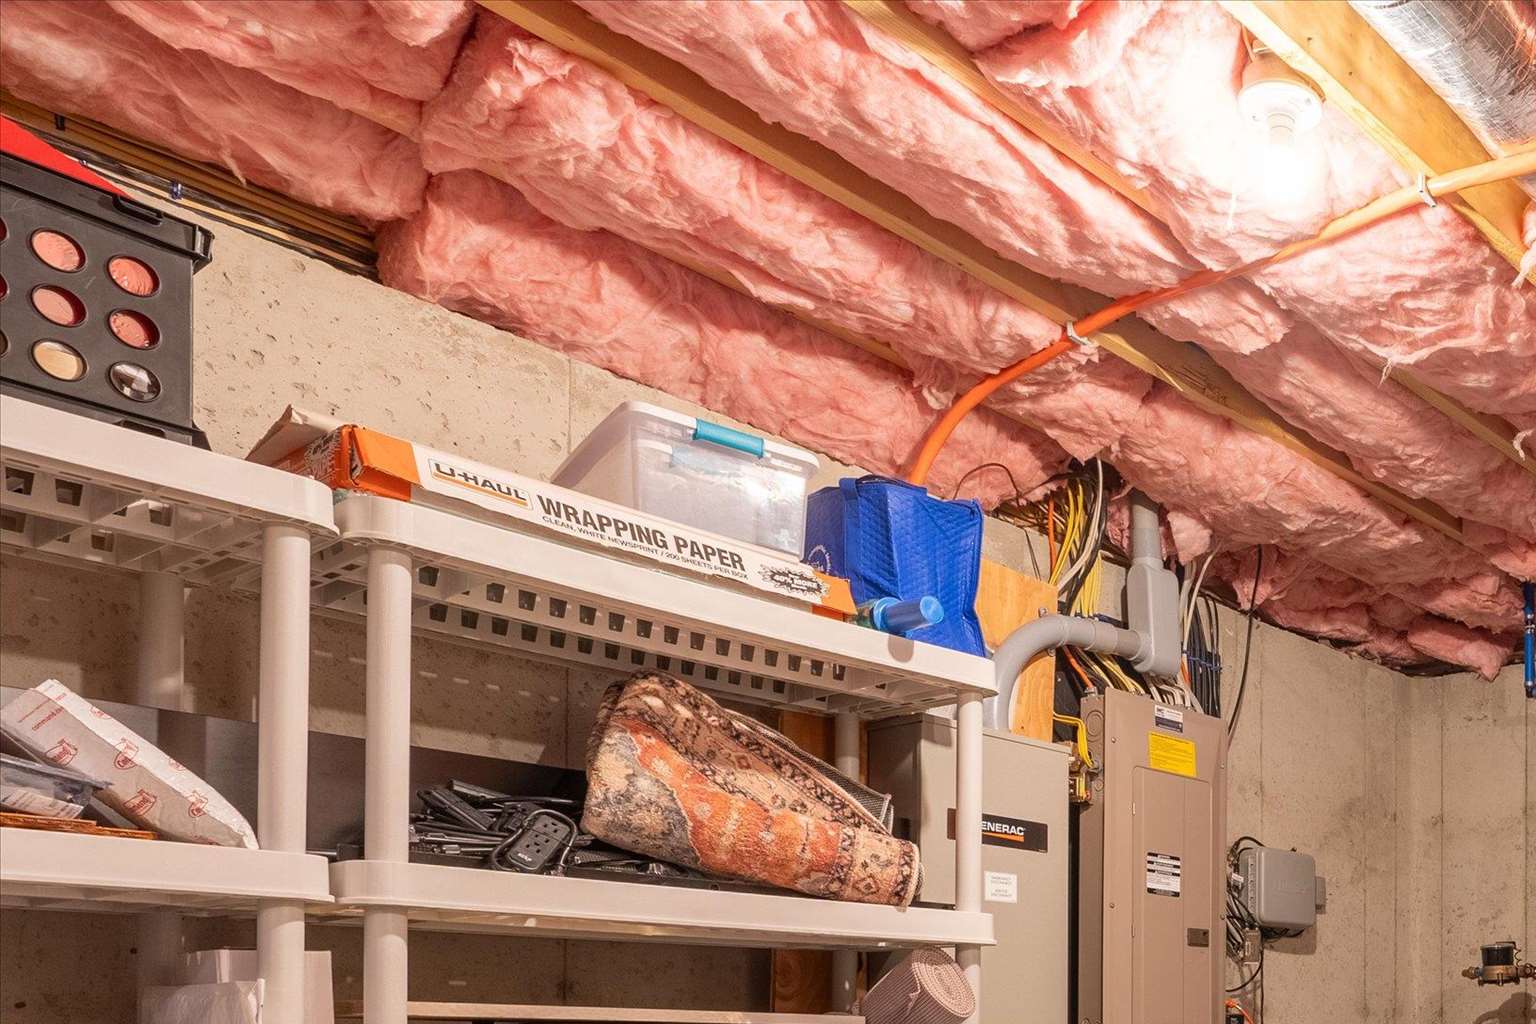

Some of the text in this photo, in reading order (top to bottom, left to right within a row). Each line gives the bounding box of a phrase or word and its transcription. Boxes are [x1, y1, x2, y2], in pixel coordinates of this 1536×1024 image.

[435, 463, 527, 501] U-HAUL
[536, 494, 745, 572] WRAPPING PAPER
[542, 515, 748, 580] CLEAN, WHITE NEWSPRINT 200 SHEETS PER BOX
[981, 821, 1025, 835] ENERAC
